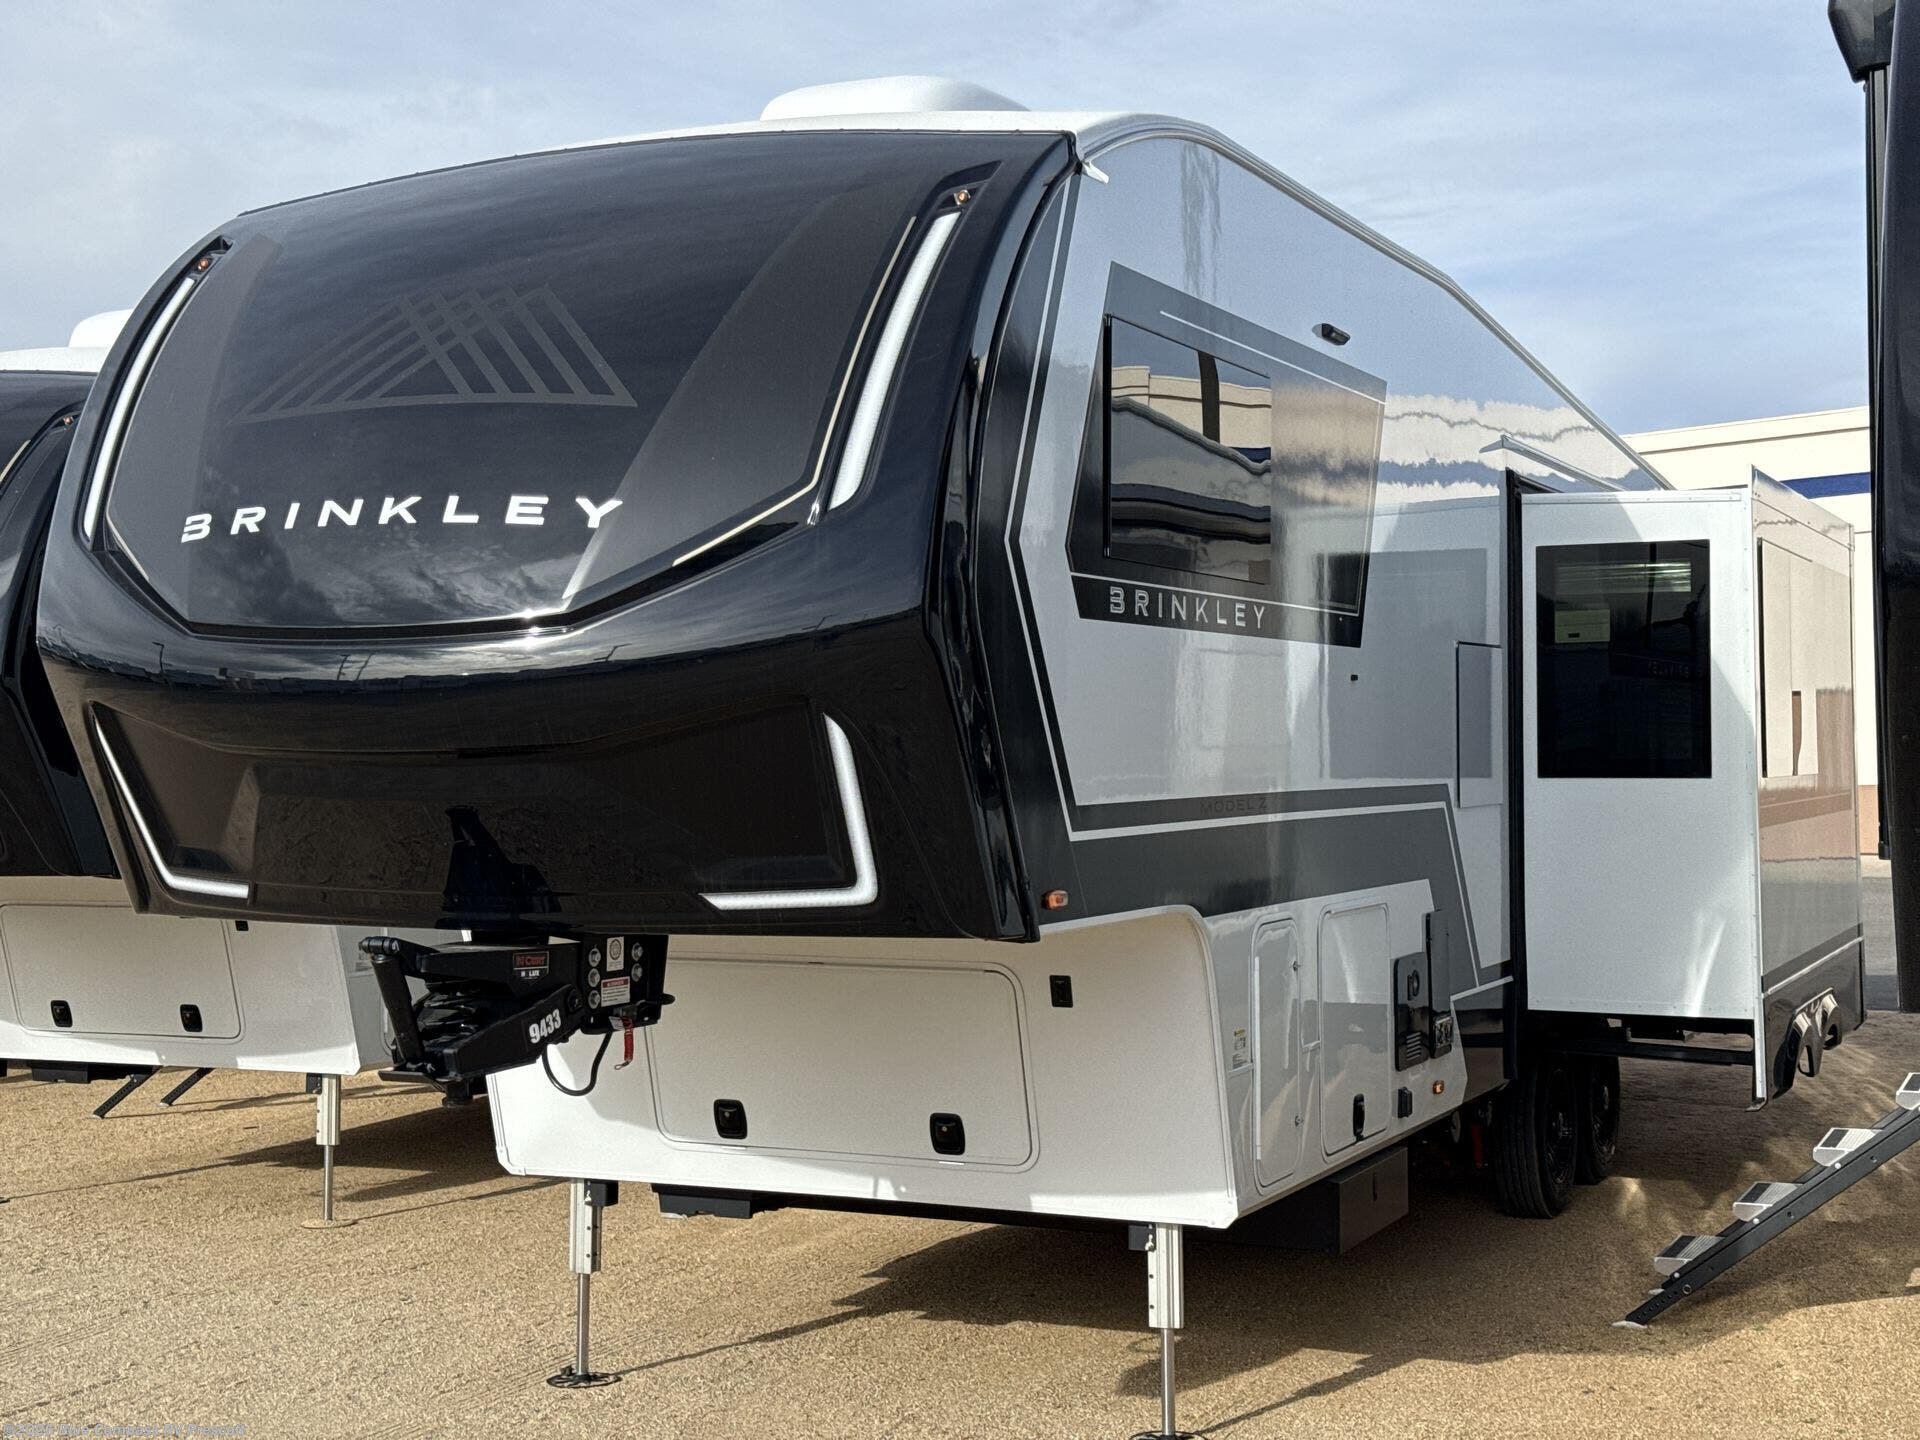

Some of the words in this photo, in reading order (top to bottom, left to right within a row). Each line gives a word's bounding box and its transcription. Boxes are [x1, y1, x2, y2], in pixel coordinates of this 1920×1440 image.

[181, 495, 624, 543] BRINKLEY
[1109, 586, 1265, 629] BRINKLEY
[1200, 798, 1254, 816] MODEL
[528, 1008, 562, 1044] 9433
